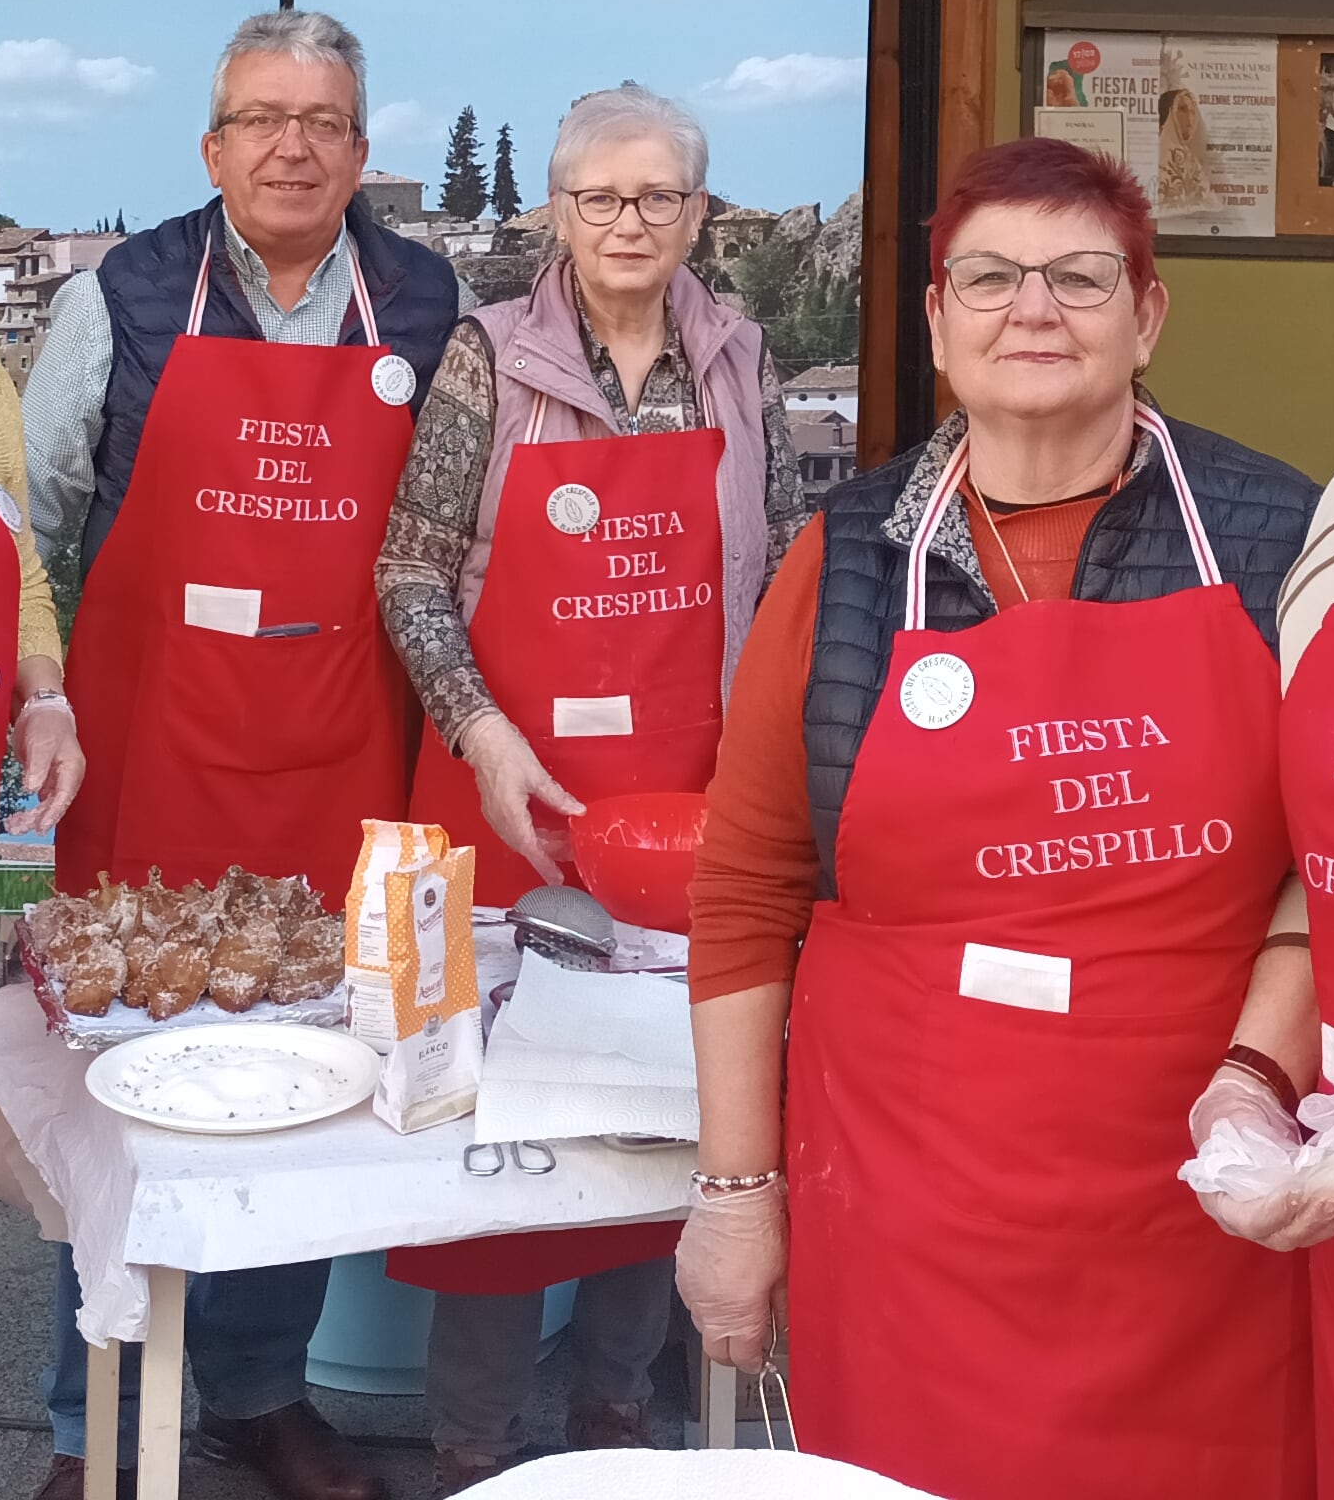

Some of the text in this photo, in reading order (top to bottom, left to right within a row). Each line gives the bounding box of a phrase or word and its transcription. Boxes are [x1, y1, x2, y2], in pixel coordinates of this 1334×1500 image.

[1092, 76, 1137, 95] FIESTA
[236, 417, 332, 447] FIESTA
[254, 458, 312, 484] DEL
[195, 488, 359, 522] CRESPILLO
[607, 551, 666, 579] DEL
[552, 582, 712, 620] CRESPILLO
[1006, 714, 1170, 763] FIESTA
[1049, 770, 1150, 814] DEL
[975, 818, 1233, 879] CRESPILLO
